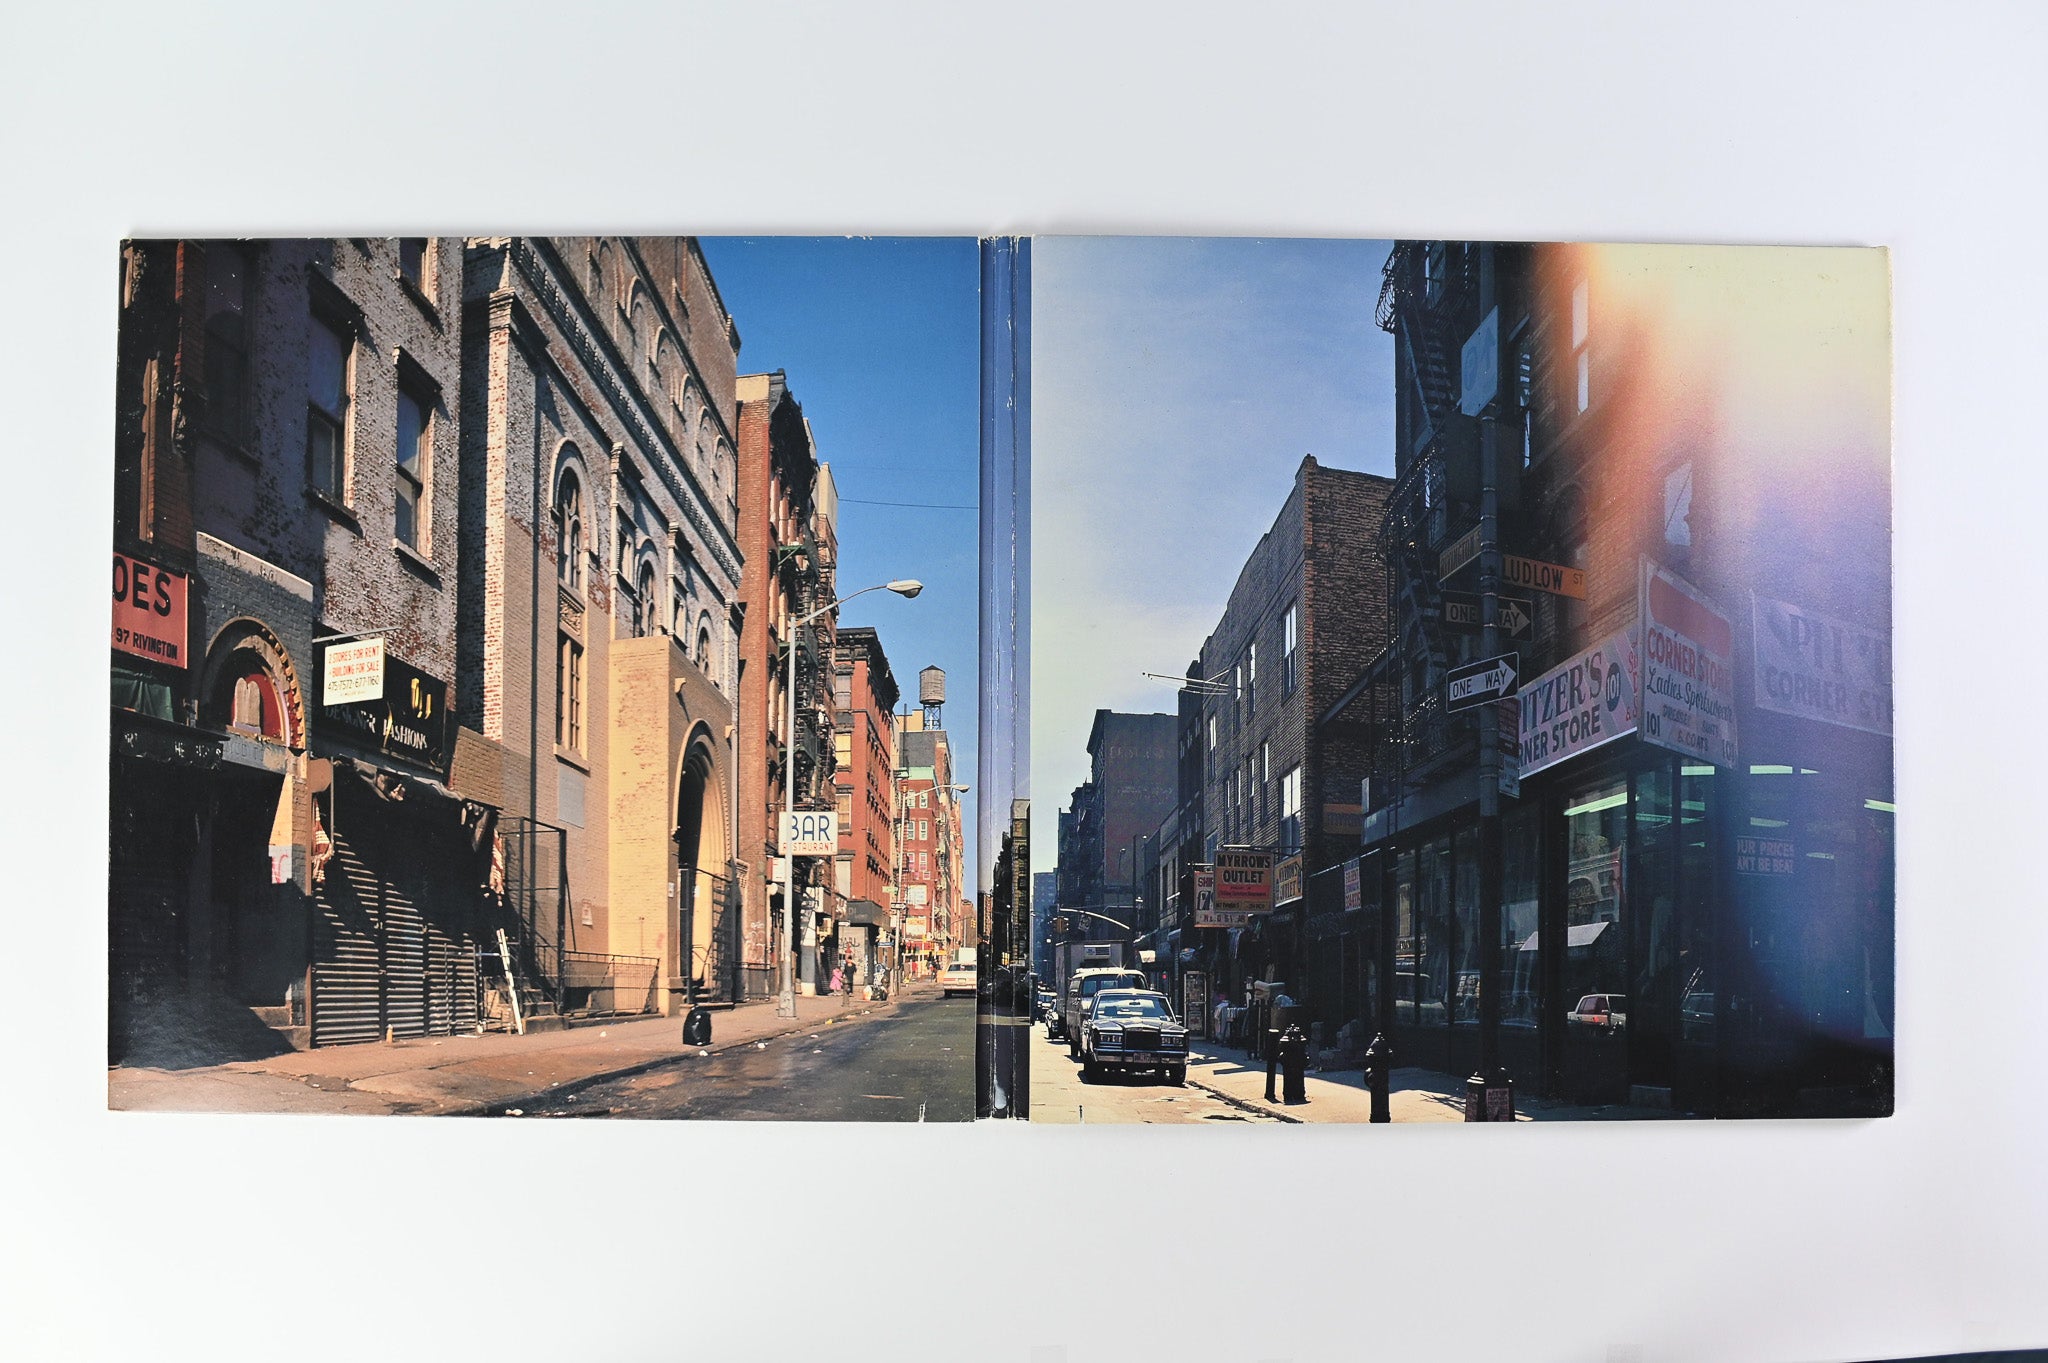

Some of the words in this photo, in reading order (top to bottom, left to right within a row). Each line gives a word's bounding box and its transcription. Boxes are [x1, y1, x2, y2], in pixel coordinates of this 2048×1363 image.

[113, 556, 171, 617] OES
[1502, 556, 1563, 591] LUDLOW
[1573, 572, 1583, 586] ST
[1450, 605, 1477, 622] ONE
[1500, 609, 1520, 627] AY
[116, 628, 130, 645] 97
[133, 632, 177, 660] RIVINGTON
[365, 645, 380, 657] RENT
[1649, 627, 1696, 680] CORNER
[1453, 679, 1472, 697] ONE
[1485, 668, 1507, 689] WAY
[1519, 652, 1602, 735] ITZER'S
[1647, 667, 1684, 700] Ladies
[1552, 704, 1600, 753] STORE
[1646, 711, 1660, 738] 101
[792, 815, 830, 841] BAR
[783, 842, 833, 851] RSTAURANT
[1223, 870, 1264, 884] OUTLET
